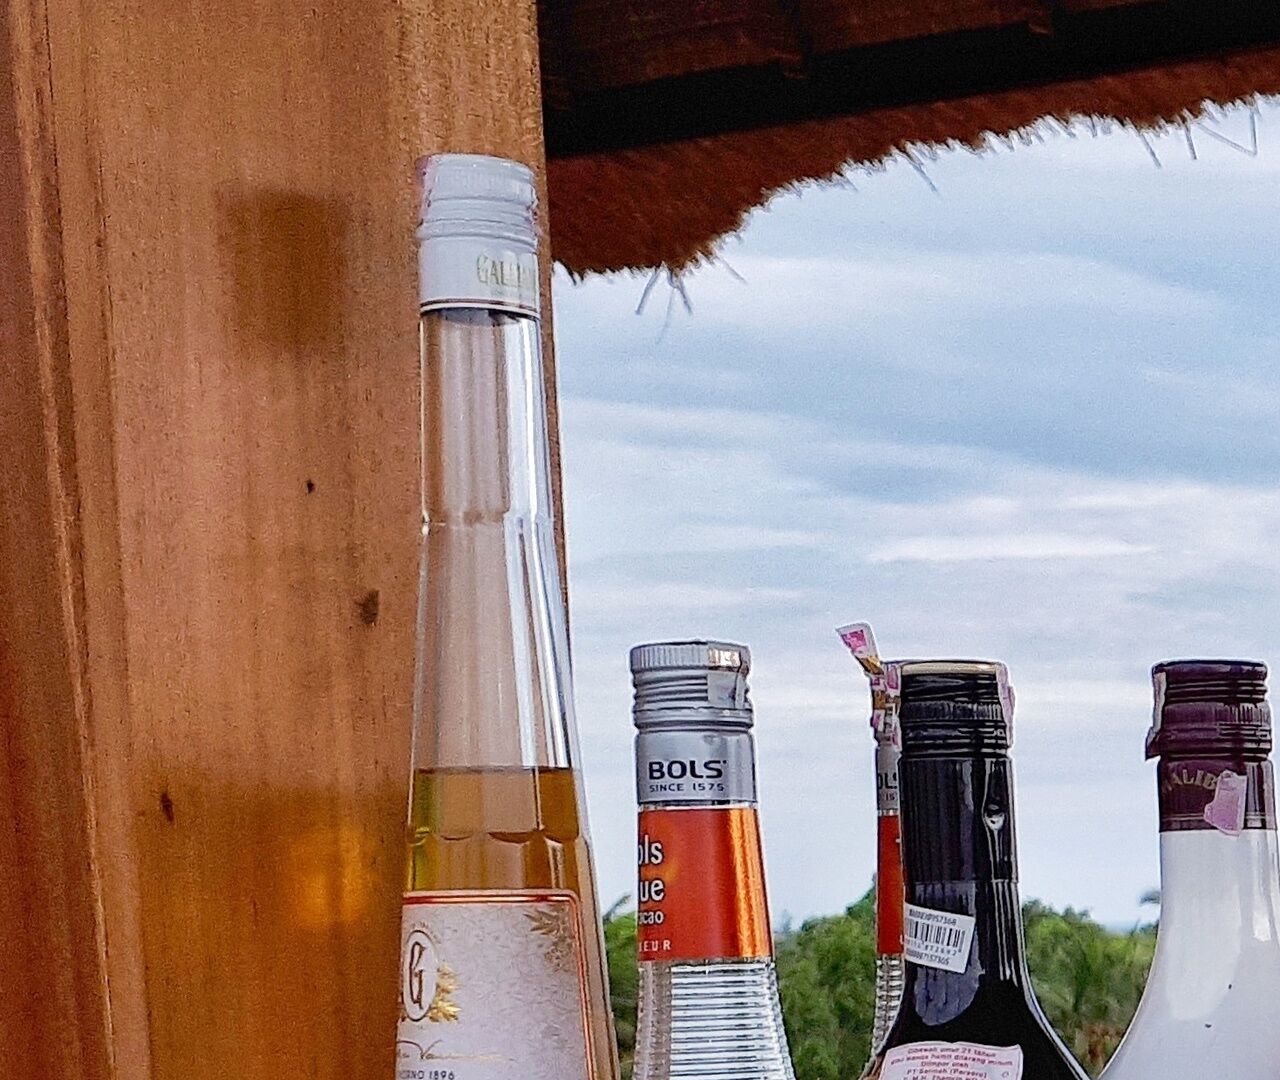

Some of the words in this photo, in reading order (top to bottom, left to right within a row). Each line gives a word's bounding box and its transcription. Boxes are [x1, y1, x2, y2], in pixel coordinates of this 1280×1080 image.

[649, 760, 723, 780] BOLS
[650, 783, 684, 792] SINCE
[693, 783, 725, 792] 1575
[428, 1070, 455, 1080] 1896
